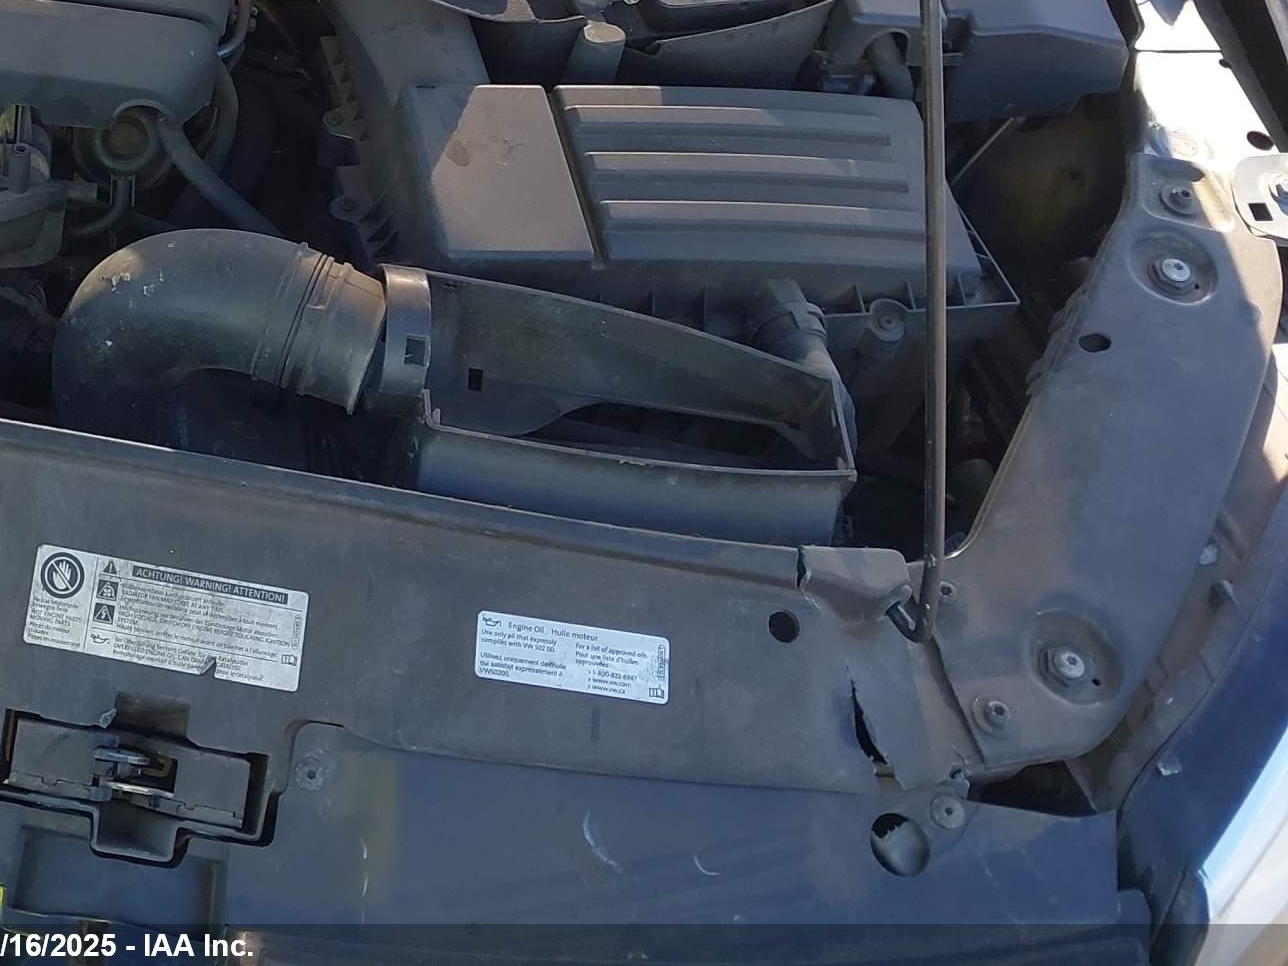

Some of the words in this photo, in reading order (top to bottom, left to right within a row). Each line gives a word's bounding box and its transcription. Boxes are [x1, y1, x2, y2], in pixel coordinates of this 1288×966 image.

[135, 568, 183, 583] ACHTUNG!
[184, 577, 231, 592] WARNING!
[232, 585, 285, 602] ATTENTION!
[508, 621, 532, 633] Engine
[534, 625, 544, 633] Oil
[551, 628, 570, 637] Huile
[571, 632, 597, 641] moteur
[480, 636, 506, 646] complies
[529, 636, 556, 645] expressly
[608, 647, 635, 657] approved
